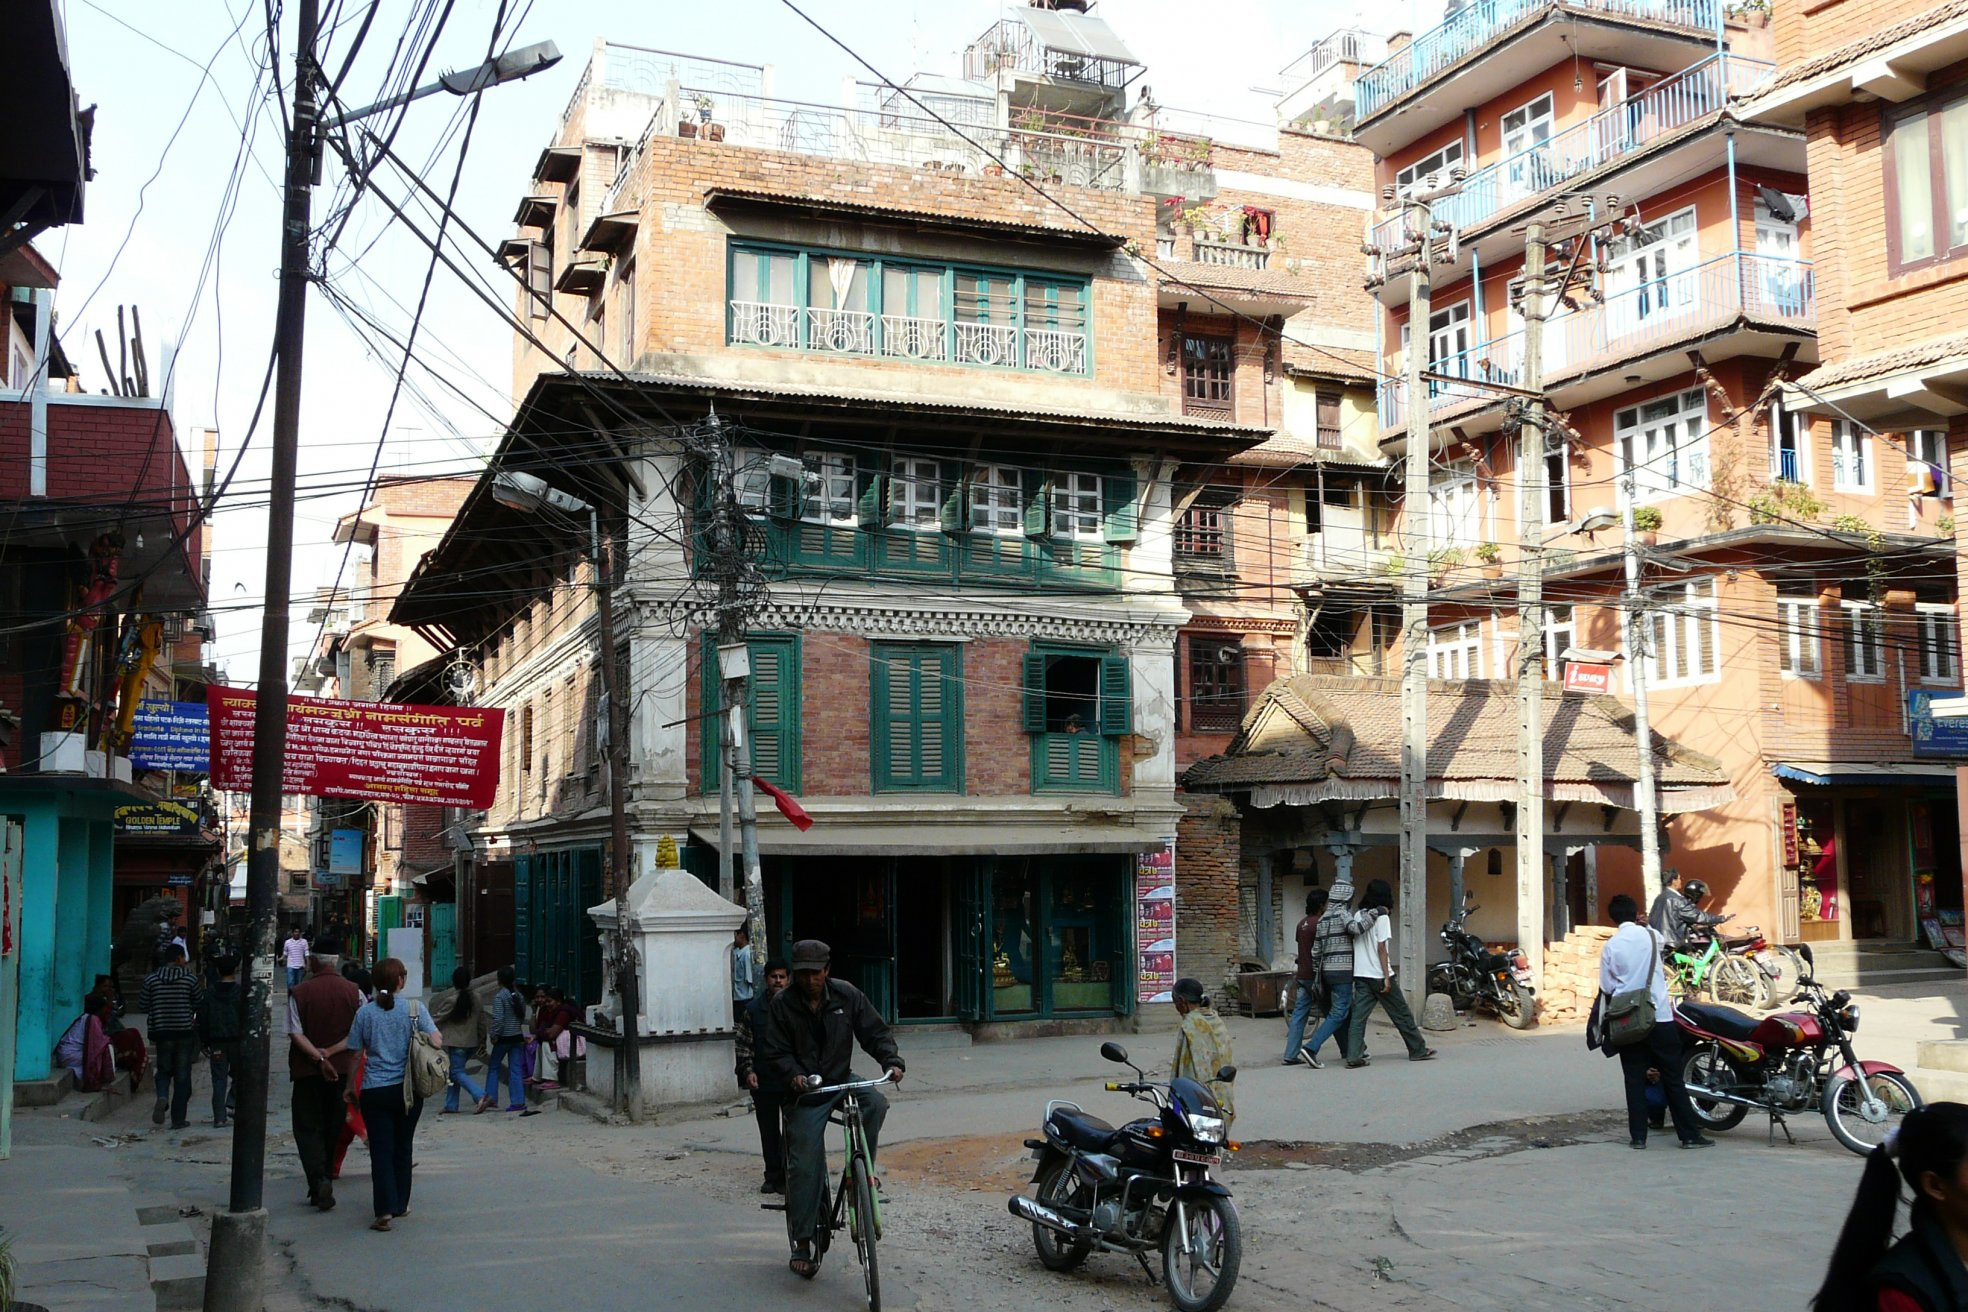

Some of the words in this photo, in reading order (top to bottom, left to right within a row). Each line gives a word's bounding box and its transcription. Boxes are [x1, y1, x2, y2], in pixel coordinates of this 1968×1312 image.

[456, 713, 485, 727] पर्व
[126, 816, 155, 825] GOLDEN
[155, 814, 181, 825] TEMPLE
